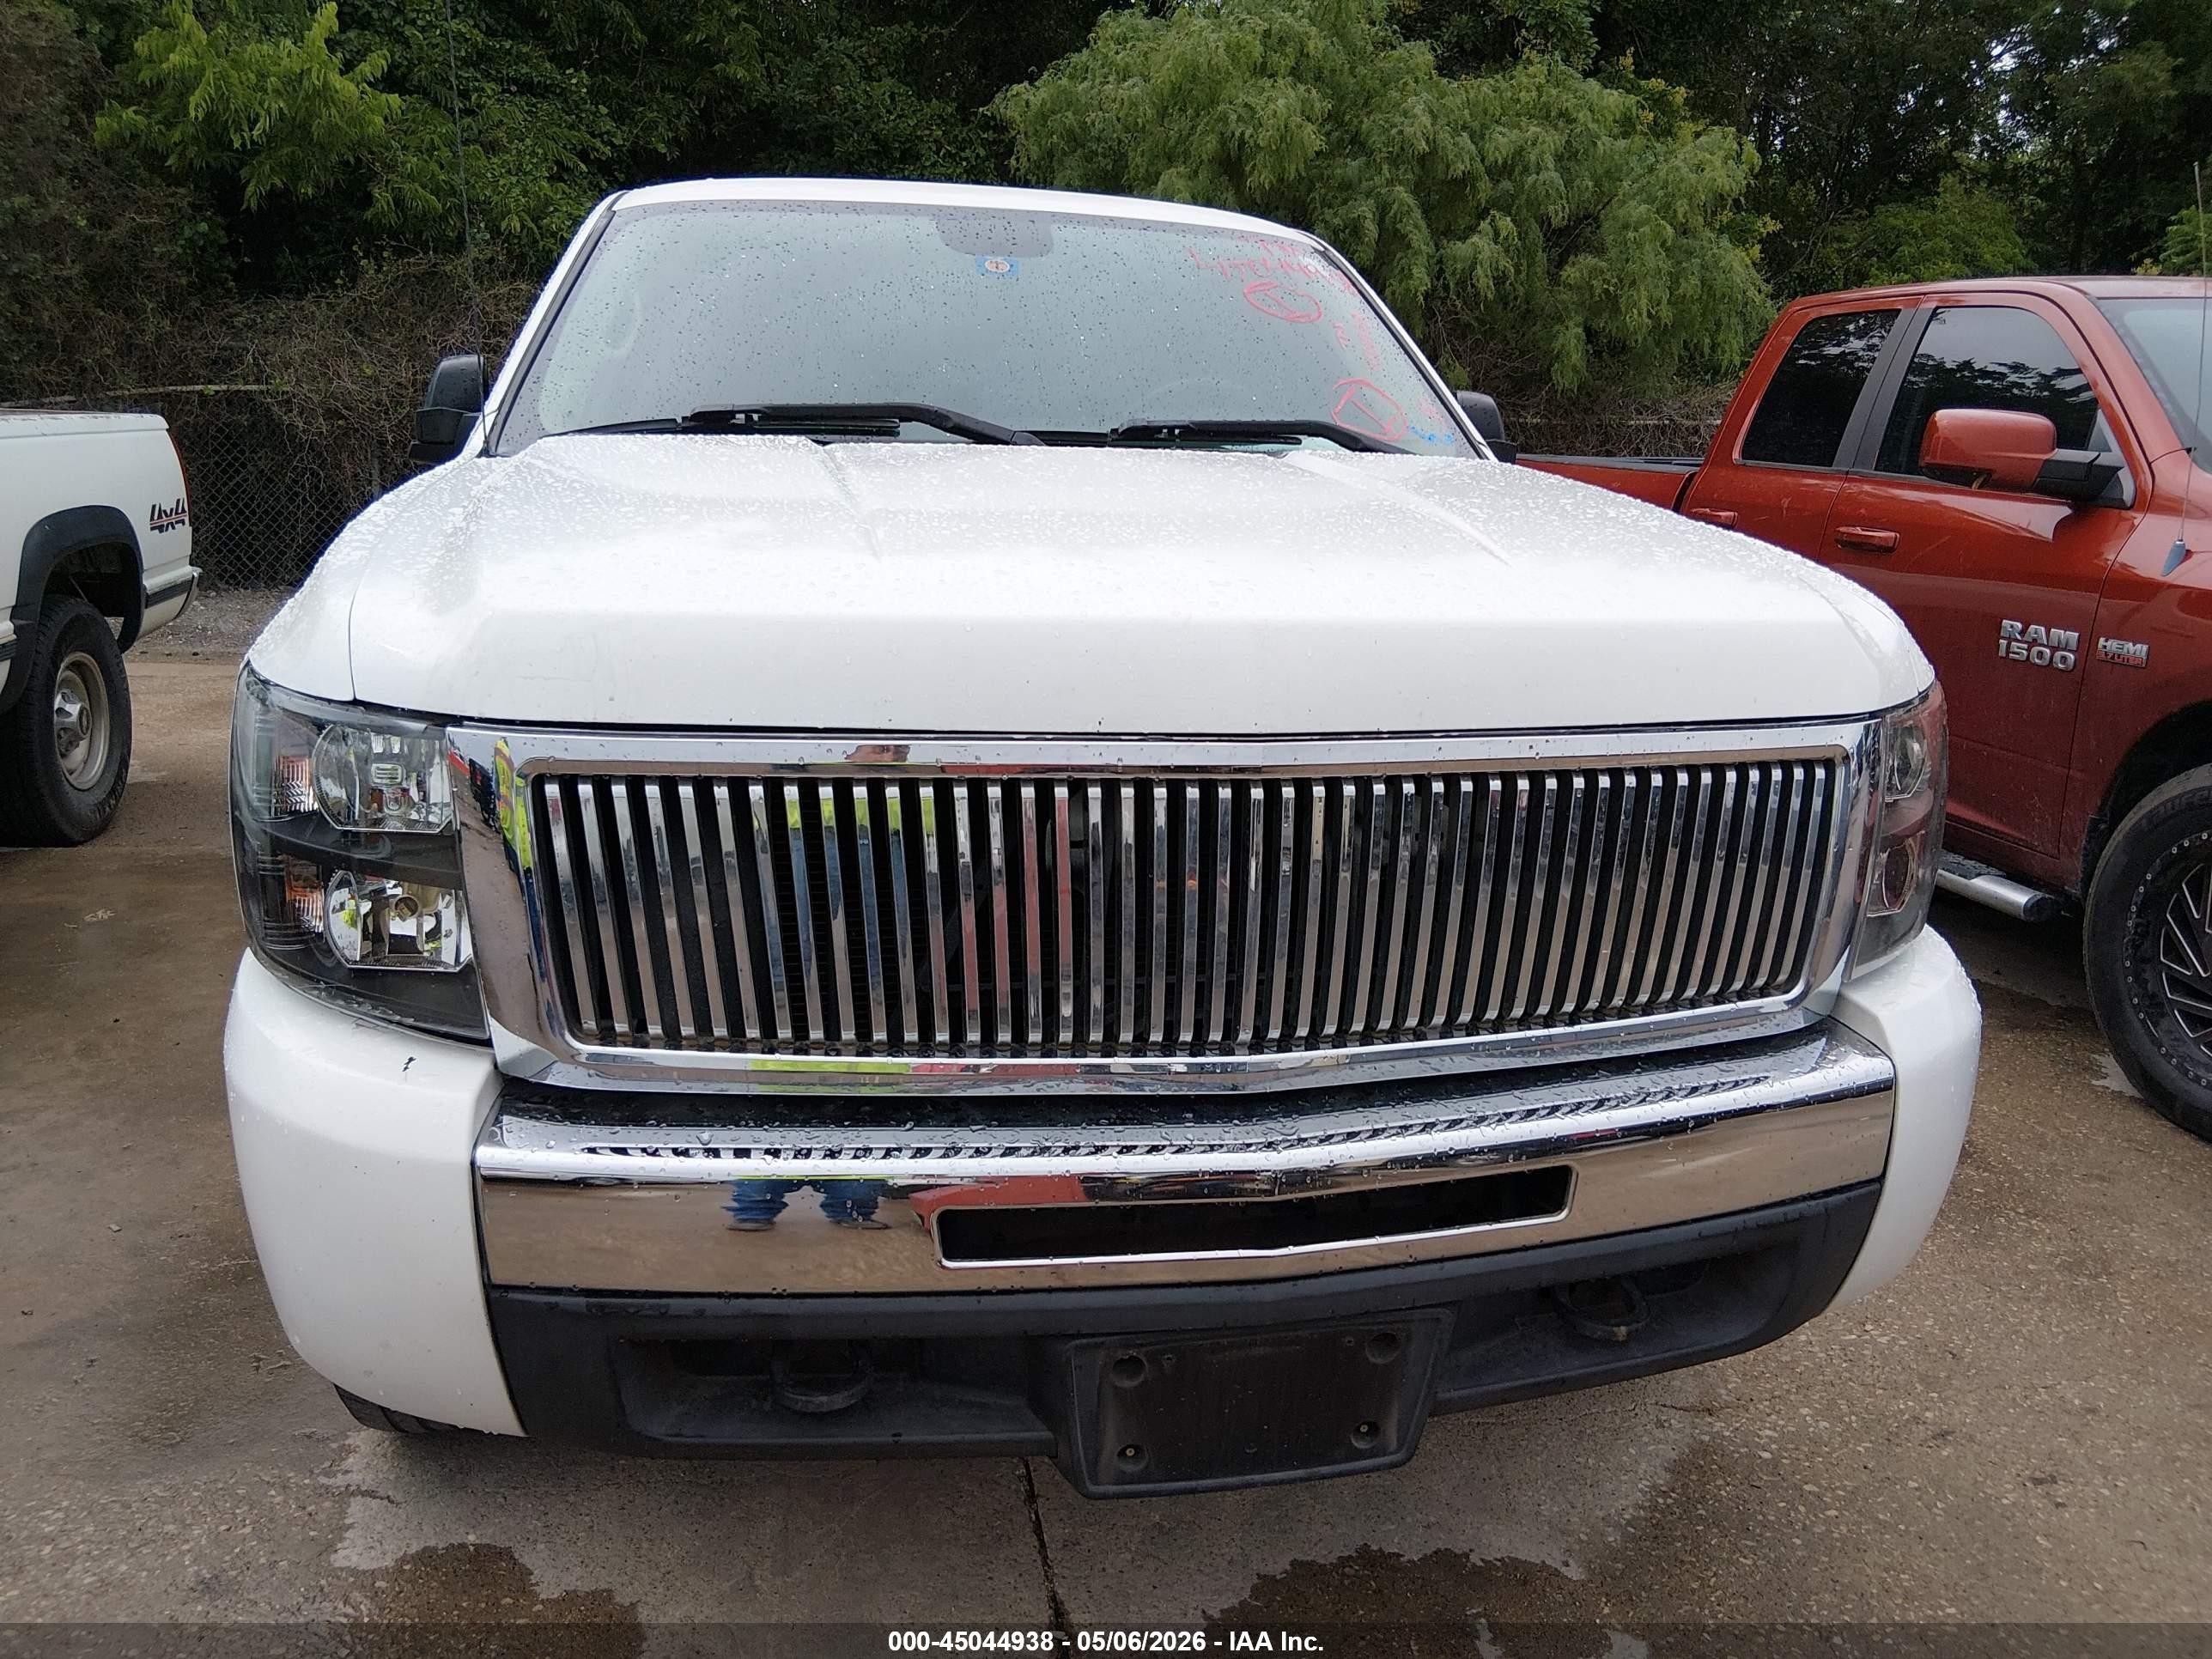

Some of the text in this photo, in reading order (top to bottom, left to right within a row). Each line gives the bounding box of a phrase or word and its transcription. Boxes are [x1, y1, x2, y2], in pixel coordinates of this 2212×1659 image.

[2001, 619, 2080, 651] RAM
[2098, 637, 2149, 658] HEMI
[1998, 639, 2075, 672] 1500
